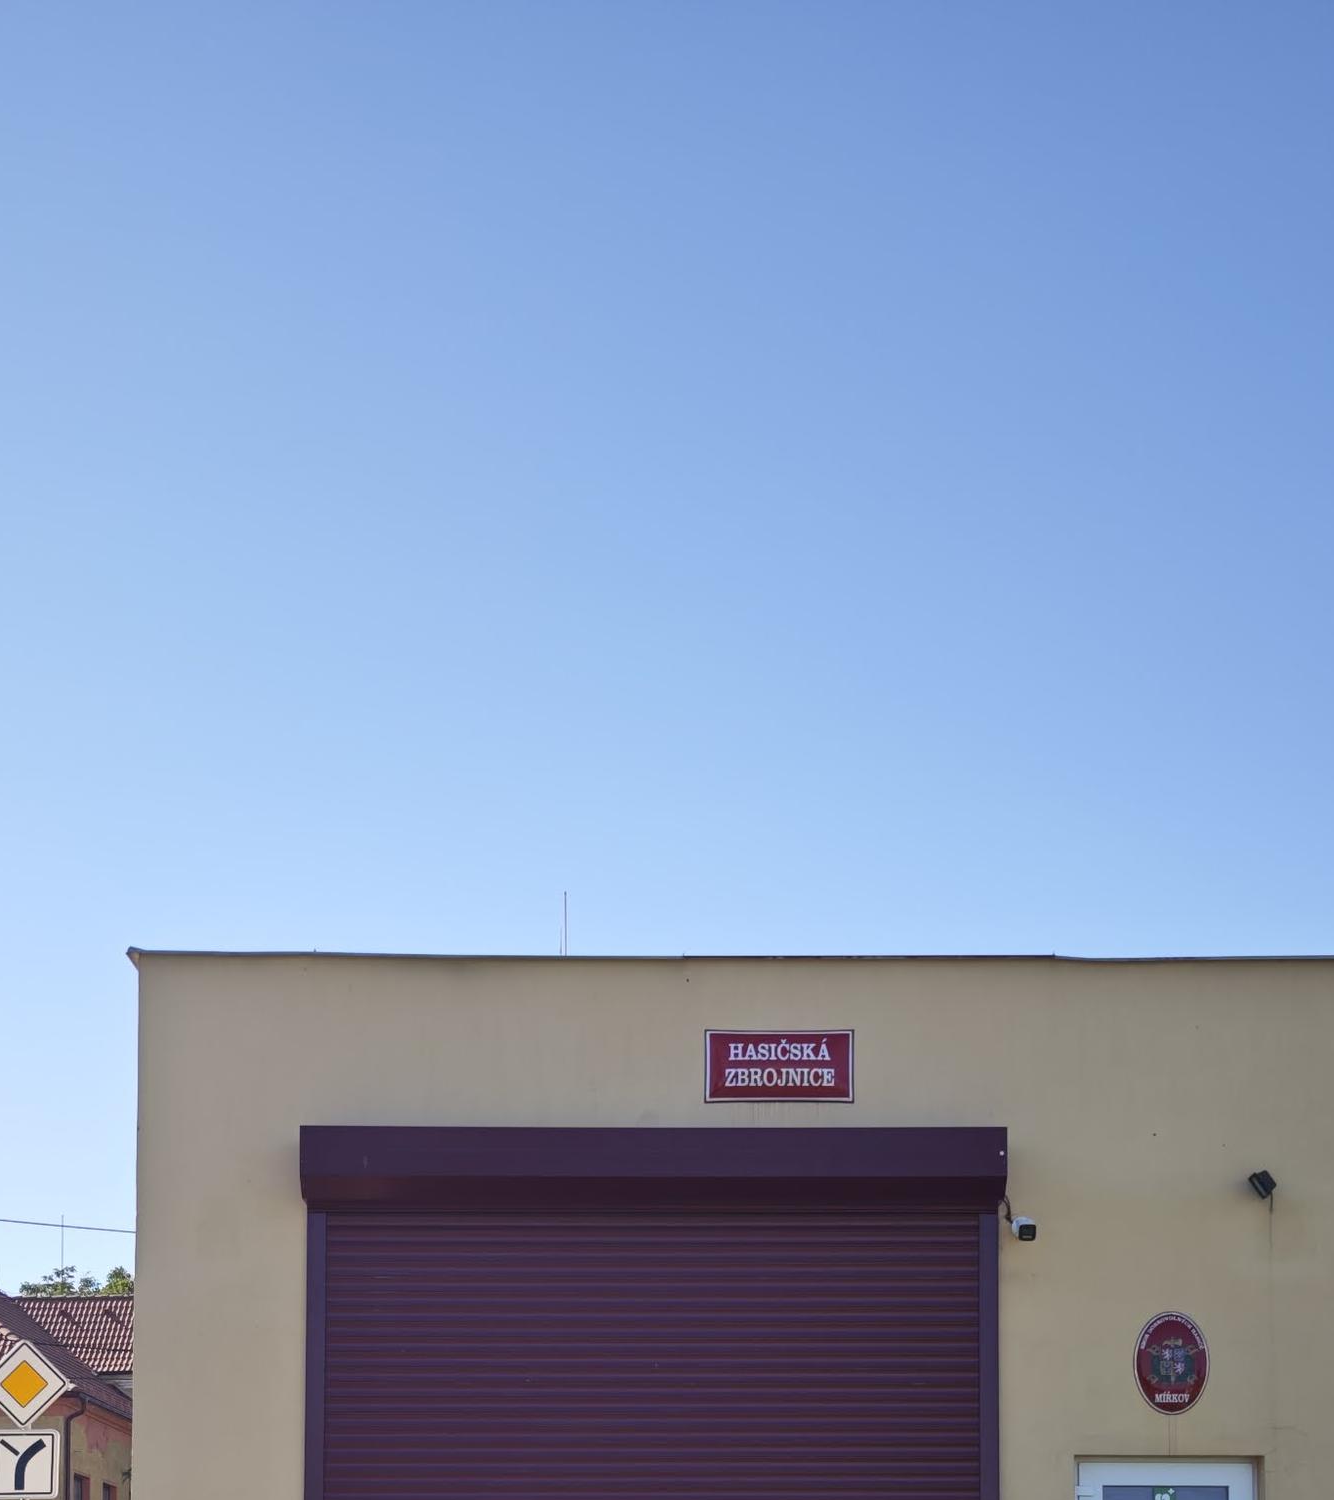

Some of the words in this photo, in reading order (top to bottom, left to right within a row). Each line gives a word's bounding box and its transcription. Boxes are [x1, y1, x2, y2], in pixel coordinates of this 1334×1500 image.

[728, 1038, 831, 1061] HASIČSKÁ
[725, 1068, 835, 1087] ZBROJNICE
[1155, 1391, 1190, 1403] MÍŘKOV
